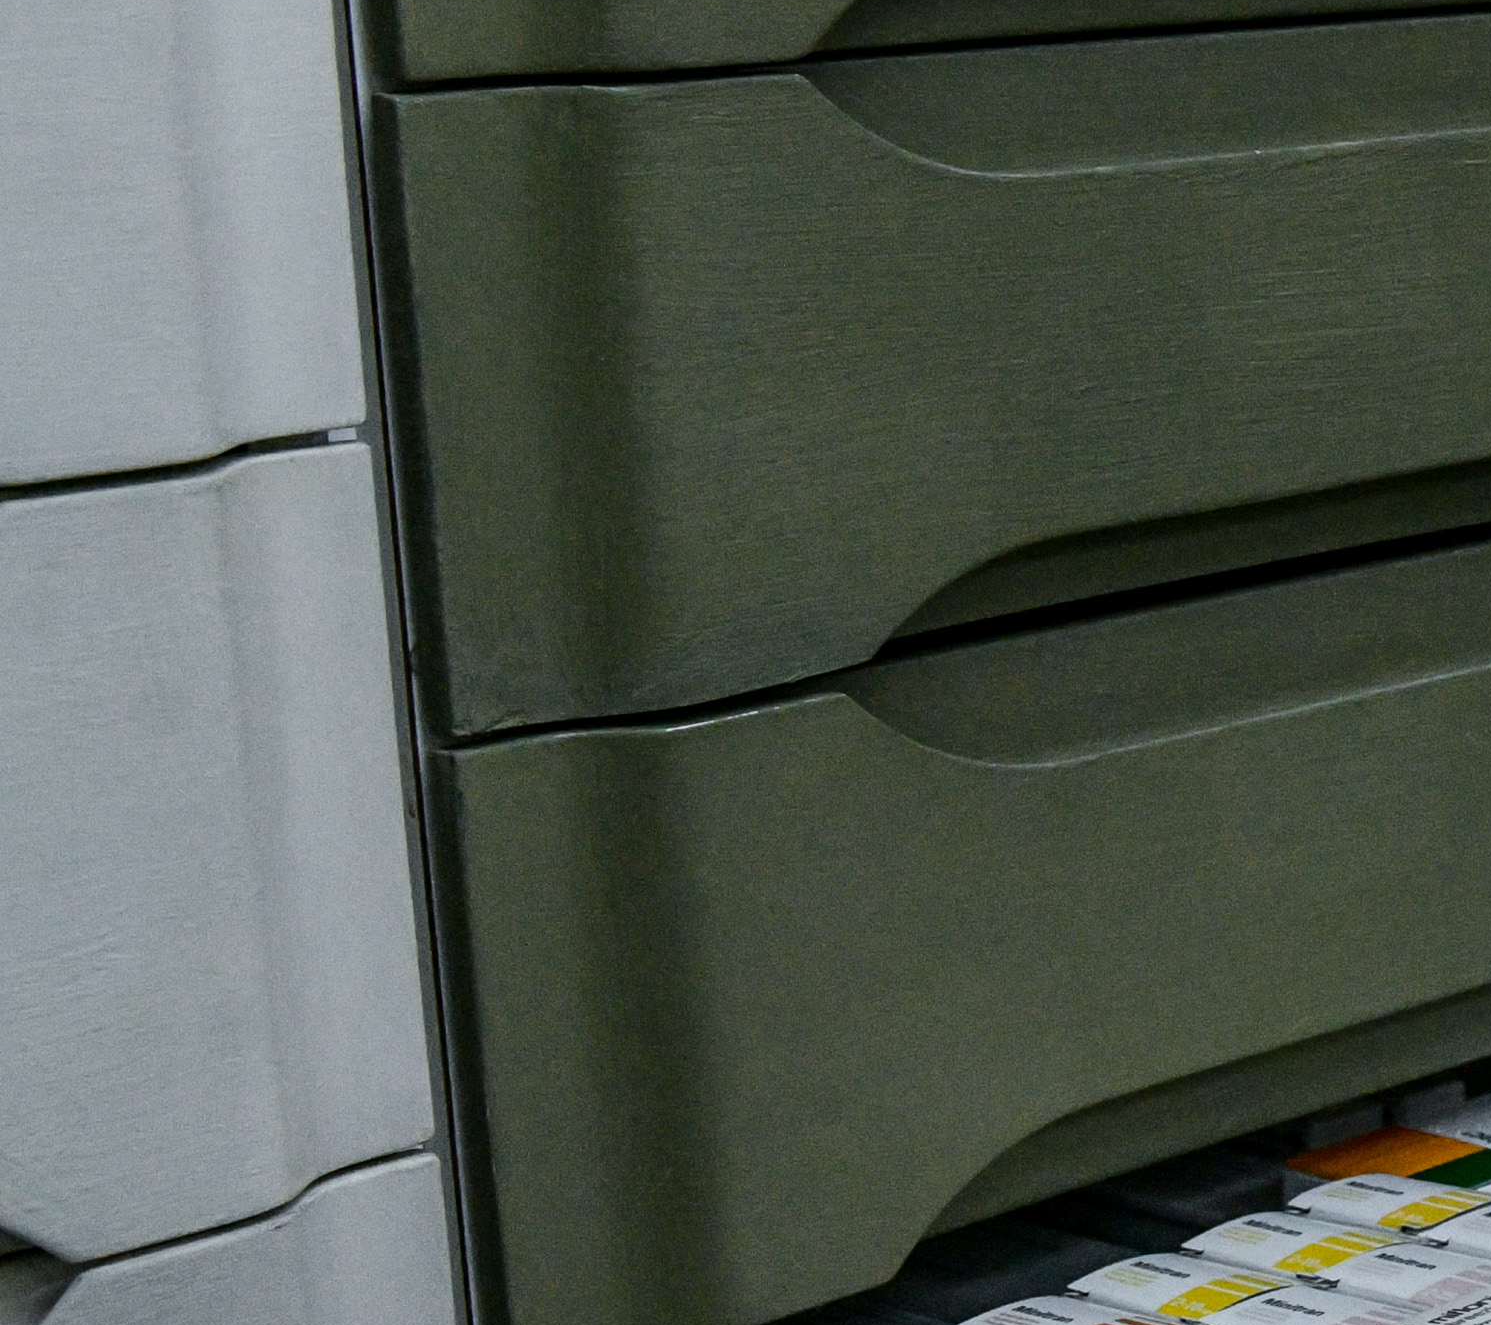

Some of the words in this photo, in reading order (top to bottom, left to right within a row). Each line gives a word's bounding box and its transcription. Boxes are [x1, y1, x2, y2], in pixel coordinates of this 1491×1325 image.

[1243, 1218, 1303, 1237] Minitran
[1375, 1252, 1437, 1270] Minitran
[1012, 1305, 1074, 1324] Minitran
[1261, 1296, 1325, 1318] Minitran
